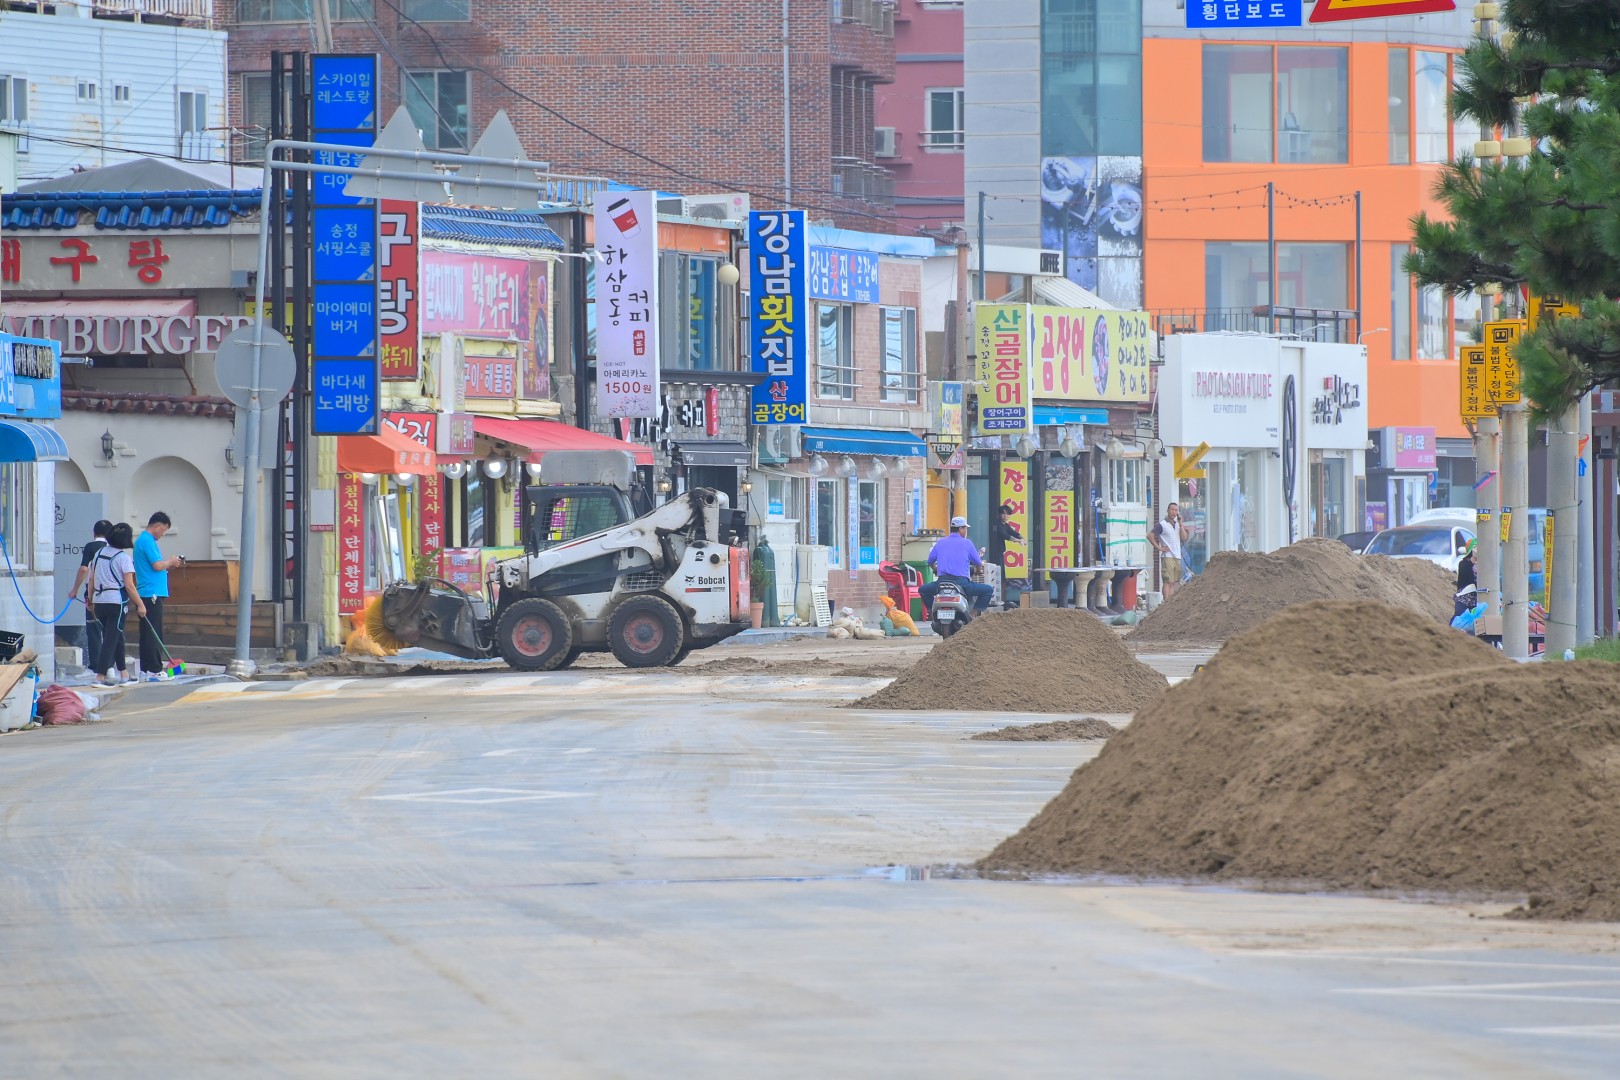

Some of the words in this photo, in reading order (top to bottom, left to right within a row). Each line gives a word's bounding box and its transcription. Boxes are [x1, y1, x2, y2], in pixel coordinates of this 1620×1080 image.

[1202, 3, 1286, 21] 횡단보도
[318, 73, 371, 87] 스카이힐
[318, 90, 371, 104] 레스토랑
[331, 224, 358, 238] 송정
[317, 242, 371, 256] 서핑스쿨
[811, 250, 849, 297] 강남횟집
[602, 245, 628, 327] 하삼동
[758, 212, 796, 376] 강남횟집
[316, 302, 372, 316] 마이애미
[628, 290, 650, 323] 커피
[331, 320, 358, 334] 버거
[1041, 314, 1085, 394] 곰장어
[603, 369, 648, 378] 아메리카노
[322, 375, 366, 389] 바다새
[769, 381, 789, 402] 산
[317, 395, 370, 413] 노래방
[754, 403, 806, 423] 곰장어
[988, 409, 1021, 417] 장어구이
[931, 443, 957, 453] TERRA
[344, 536, 361, 594] 단체환영
